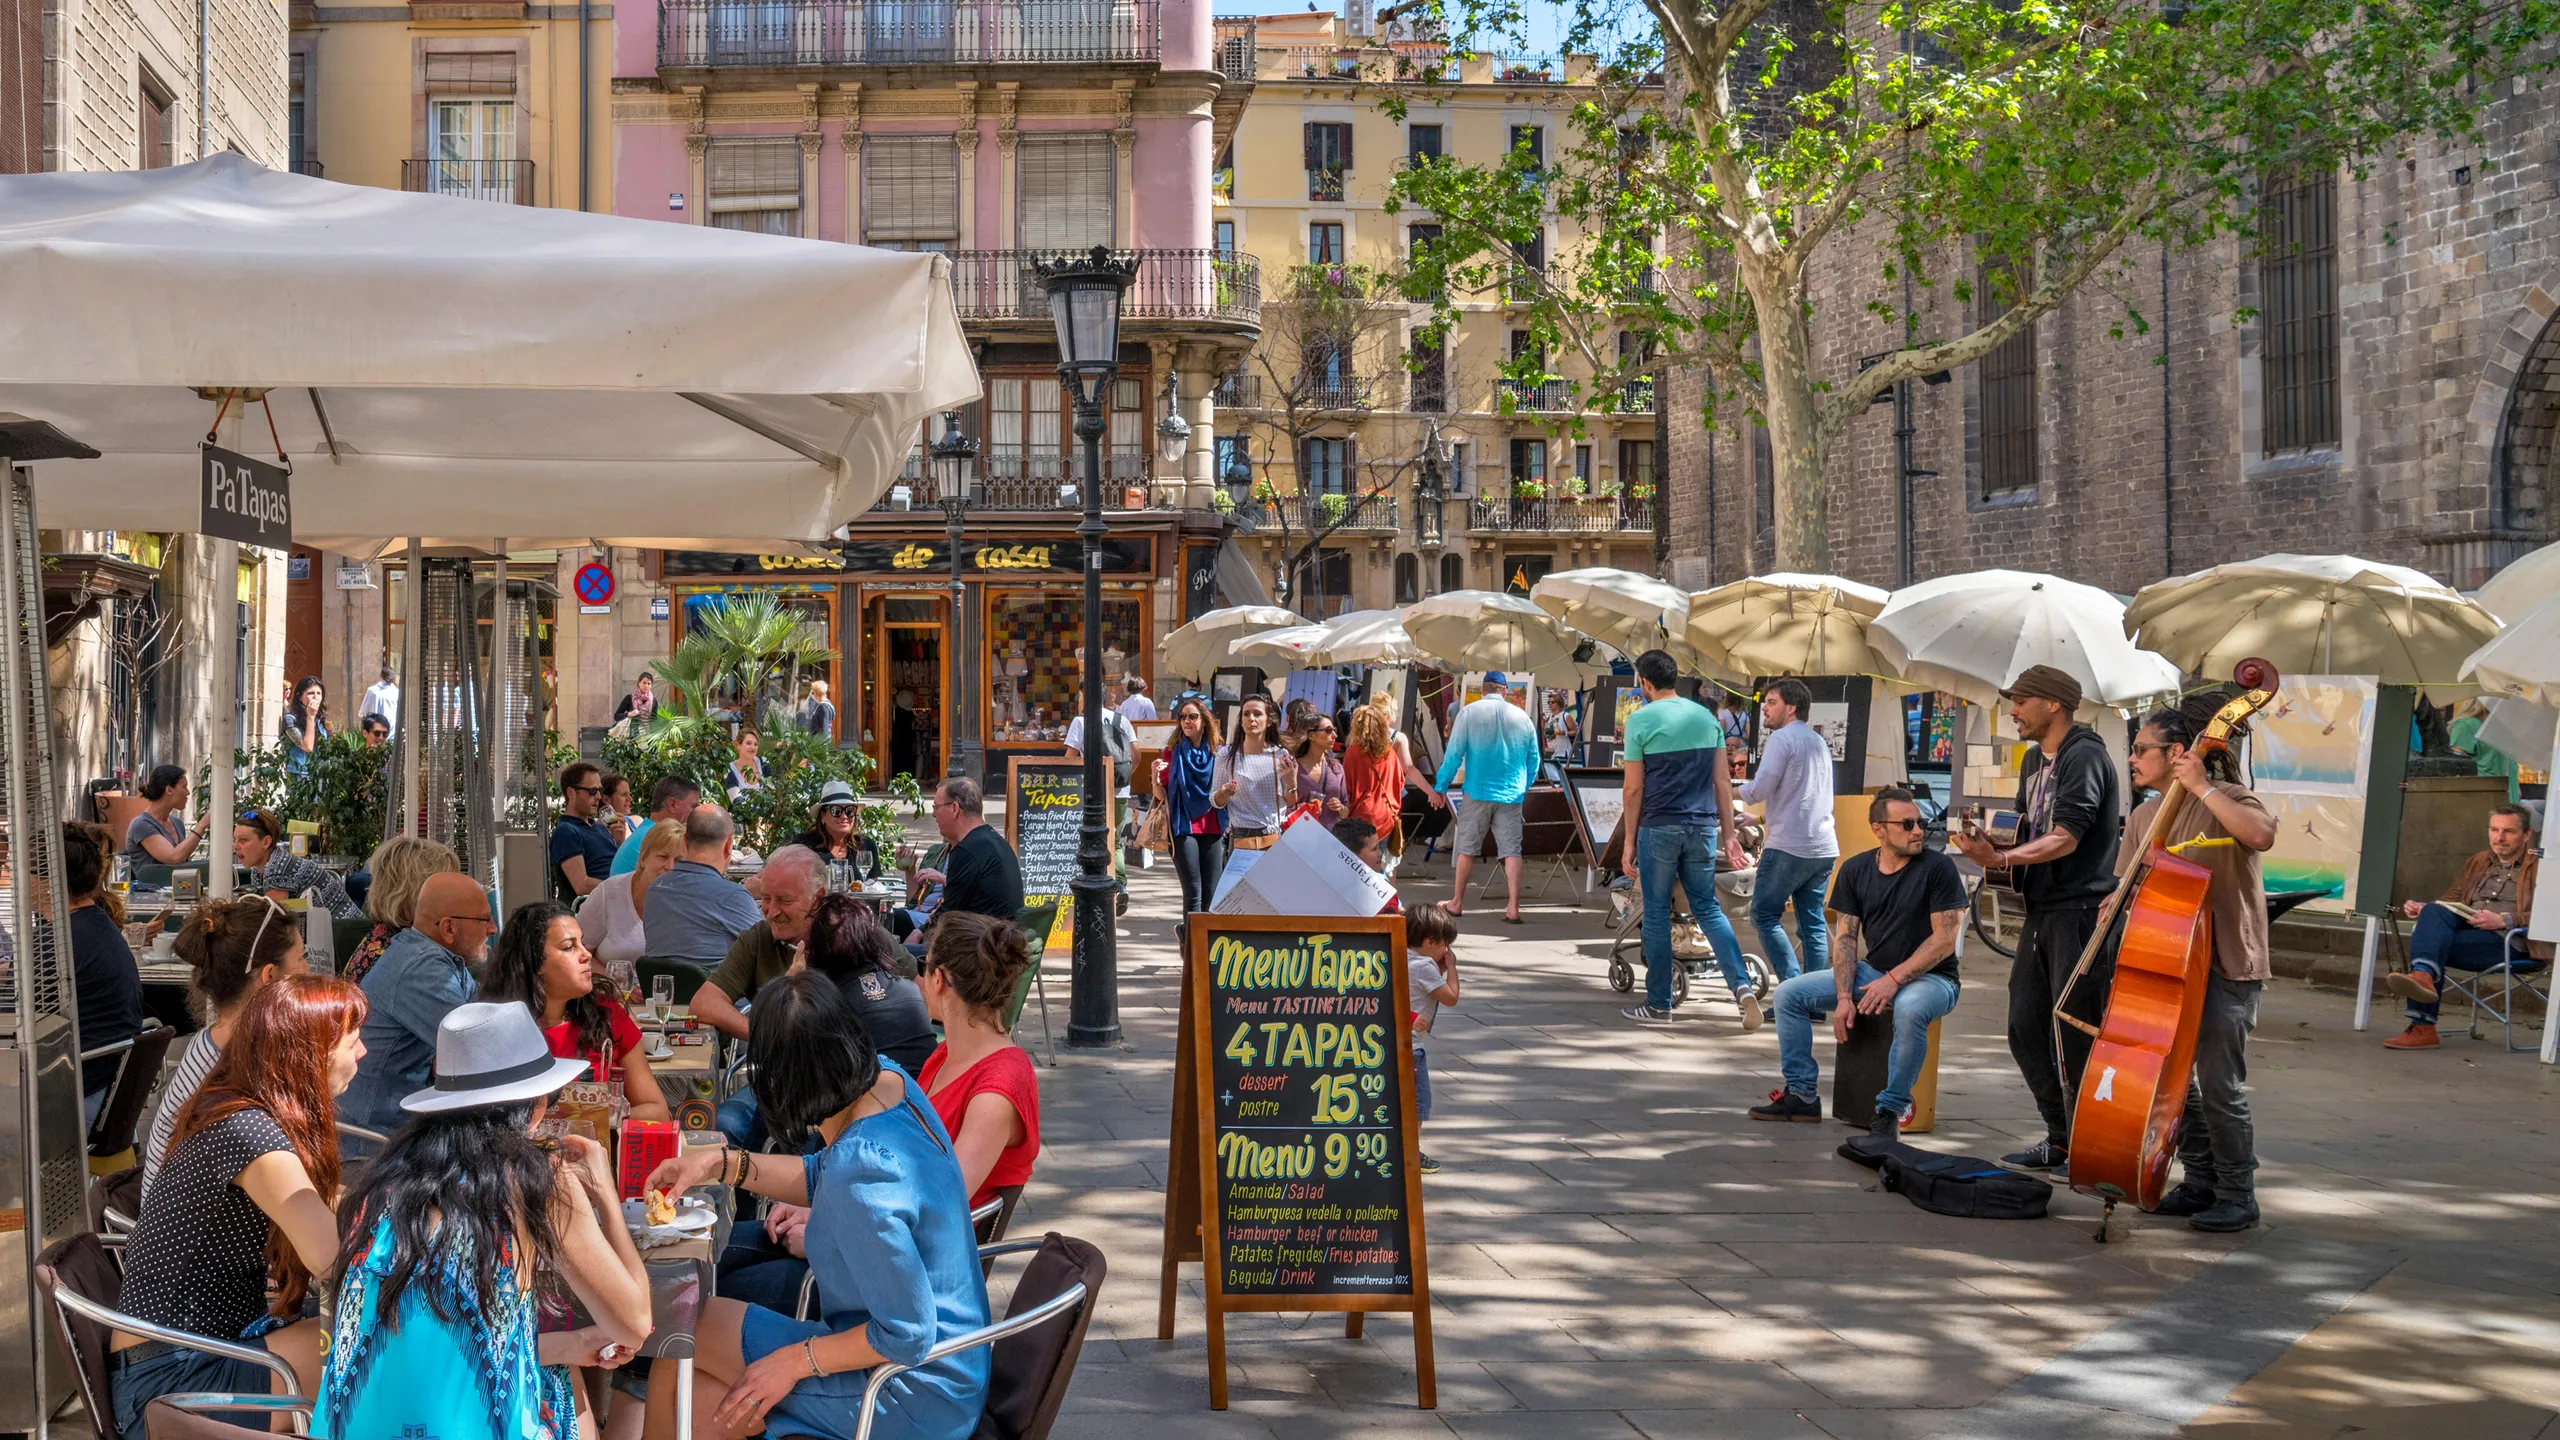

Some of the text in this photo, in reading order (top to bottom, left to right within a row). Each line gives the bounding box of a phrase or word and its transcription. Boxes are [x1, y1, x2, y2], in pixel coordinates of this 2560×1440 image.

[892, 543, 935, 569] de
[1021, 773, 1060, 788] BAR
[1025, 789, 1081, 810] Tapas
[1024, 820, 1046, 833] Large
[1046, 821, 1063, 831] Ham
[1023, 830, 1057, 843] Spanish
[1025, 841, 1051, 853] Spiced
[1025, 862, 1058, 873] Galician
[1306, 934, 1388, 994] Tapas
[1226, 996, 1268, 1014] Menu
[1225, 1021, 1386, 1069] 4 TAPAS
[1239, 1072, 1289, 1091] dessert
[1238, 1100, 1280, 1119] postre
[624, 1125, 643, 1196] Estrella
[1218, 1131, 1317, 1180] Menú
[1227, 1203, 1399, 1225] Hamburguesa vedella o pollastre
[1227, 1224, 1379, 1245] Hamburger beef or chicken
[1229, 1243, 1273, 1263] Patates
[1355, 1246, 1399, 1267] potatoes
[1281, 1267, 1316, 1286] Drink
[1394, 1274, 1409, 1285] 10%
